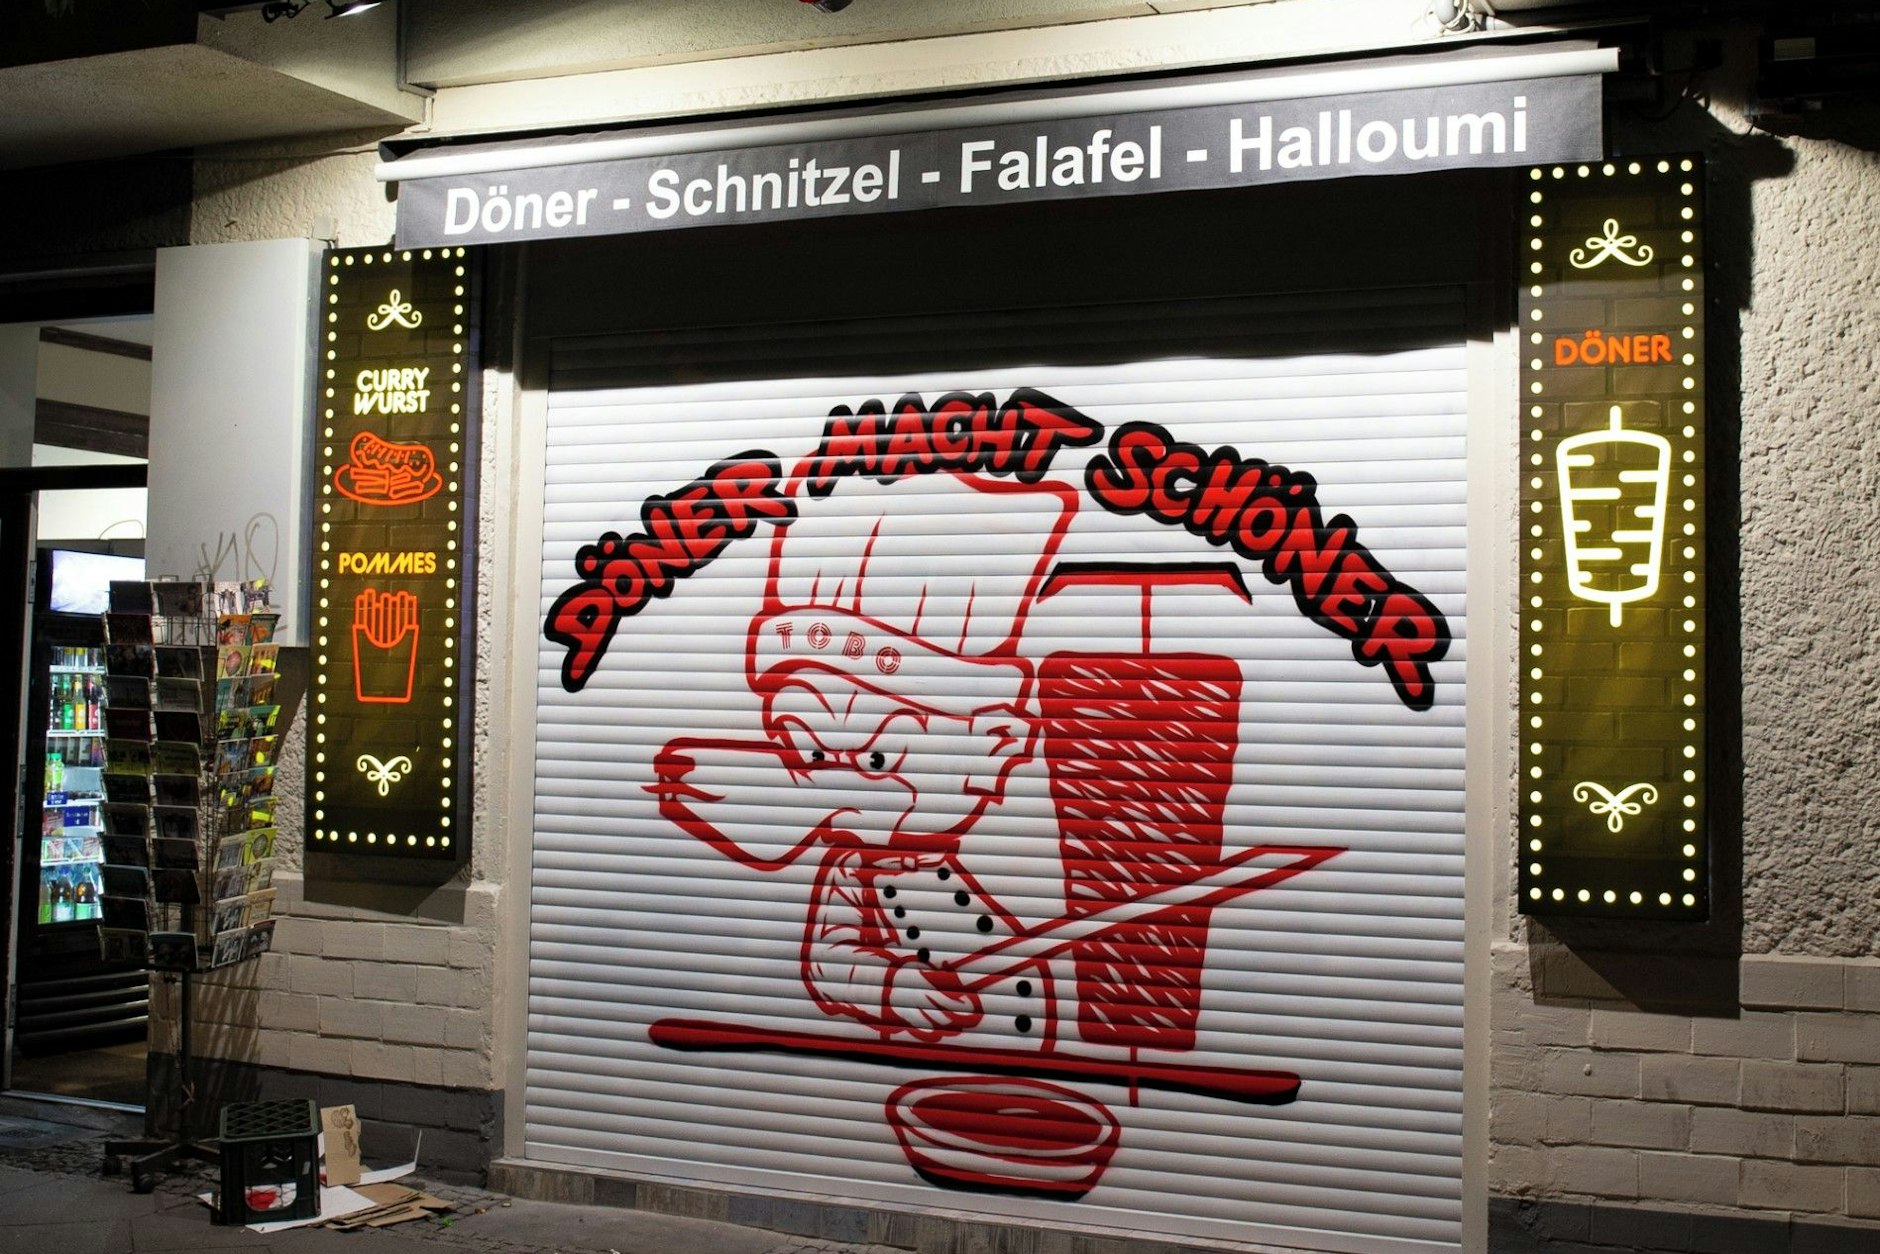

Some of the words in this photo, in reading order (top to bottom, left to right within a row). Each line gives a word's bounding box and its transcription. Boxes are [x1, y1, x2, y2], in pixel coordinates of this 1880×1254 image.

[444, 185, 597, 235] Döner
[645, 150, 900, 220] Schnitzel
[959, 125, 1162, 193] Falafel
[1229, 95, 1527, 173] Halloumi
[1554, 329, 1674, 366] DÖNER
[356, 367, 430, 393] CURRY
[353, 390, 430, 416] WURST
[338, 552, 437, 575] POMMES
[543, 449, 799, 693] DÖNER
[806, 387, 1105, 501] MACHT
[1084, 421, 1451, 712] SCHÖNER
[775, 622, 902, 674] TOBO
